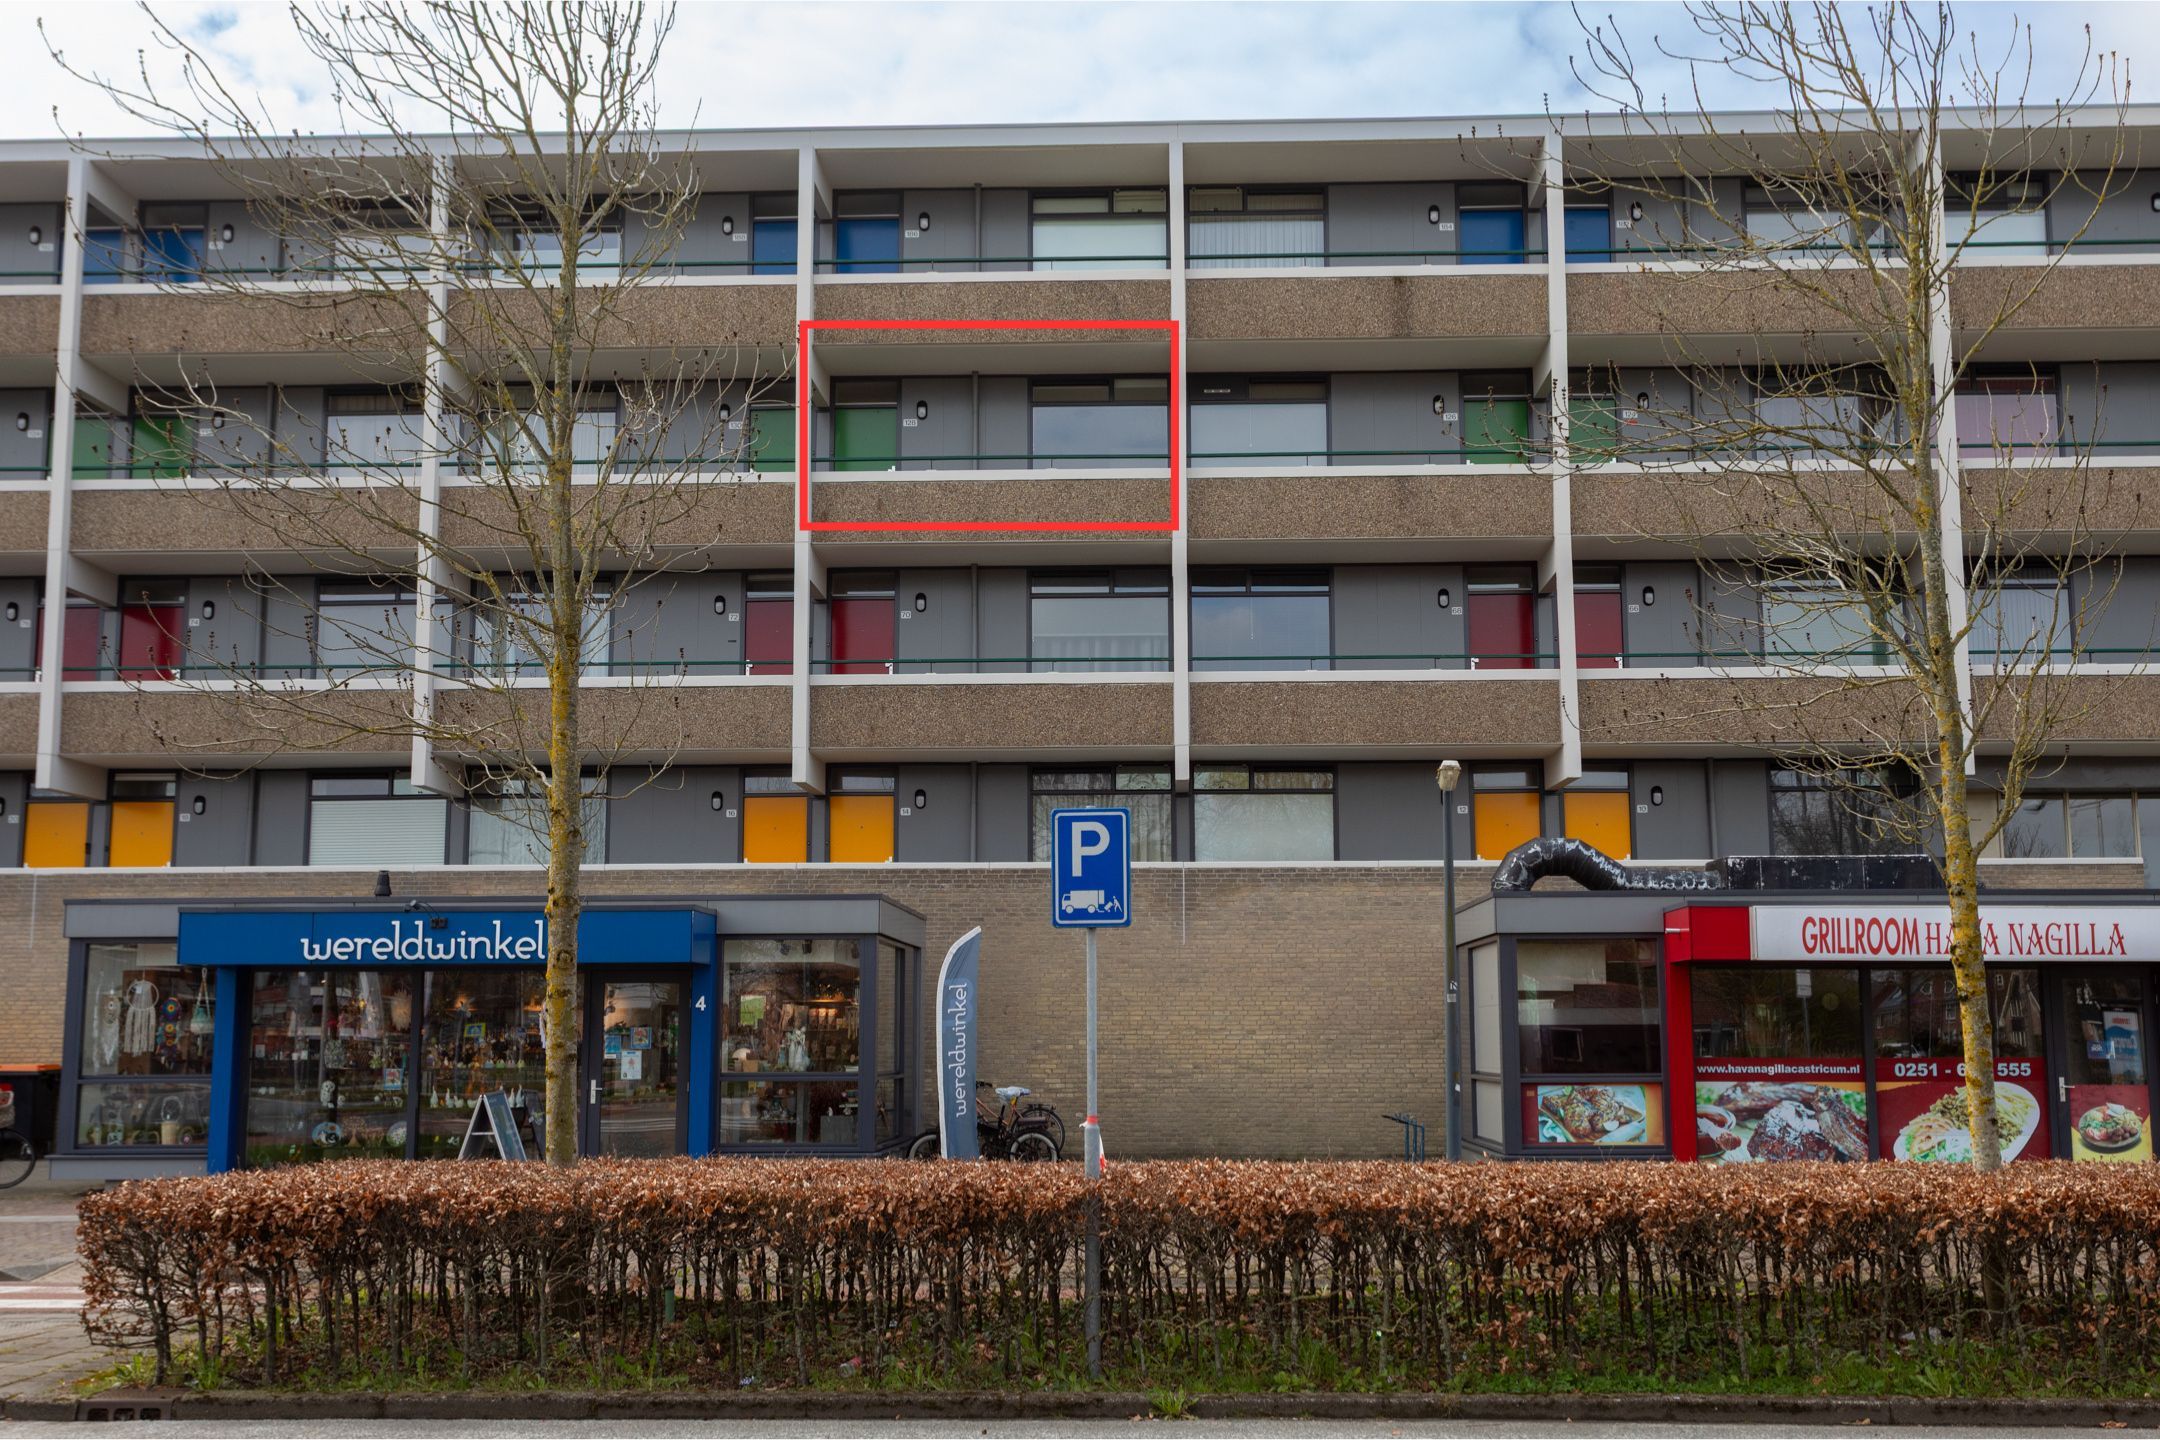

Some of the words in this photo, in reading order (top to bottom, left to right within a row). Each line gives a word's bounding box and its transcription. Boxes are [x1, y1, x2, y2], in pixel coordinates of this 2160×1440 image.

[1072, 821, 1110, 877] P
[300, 920, 545, 961] wereldwinkel
[1802, 916, 1920, 955] GRILLROOM
[1925, 916, 2001, 955] HA
[2008, 923, 2128, 955] NAGILLA
[695, 995, 706, 1011] 4
[948, 982, 968, 1118] wereldwinkel
[1697, 1063, 1860, 1076] www.havanagillacastricum.nl
[1894, 1062, 1938, 1077] 0251
[1997, 1062, 2032, 1077] 555
